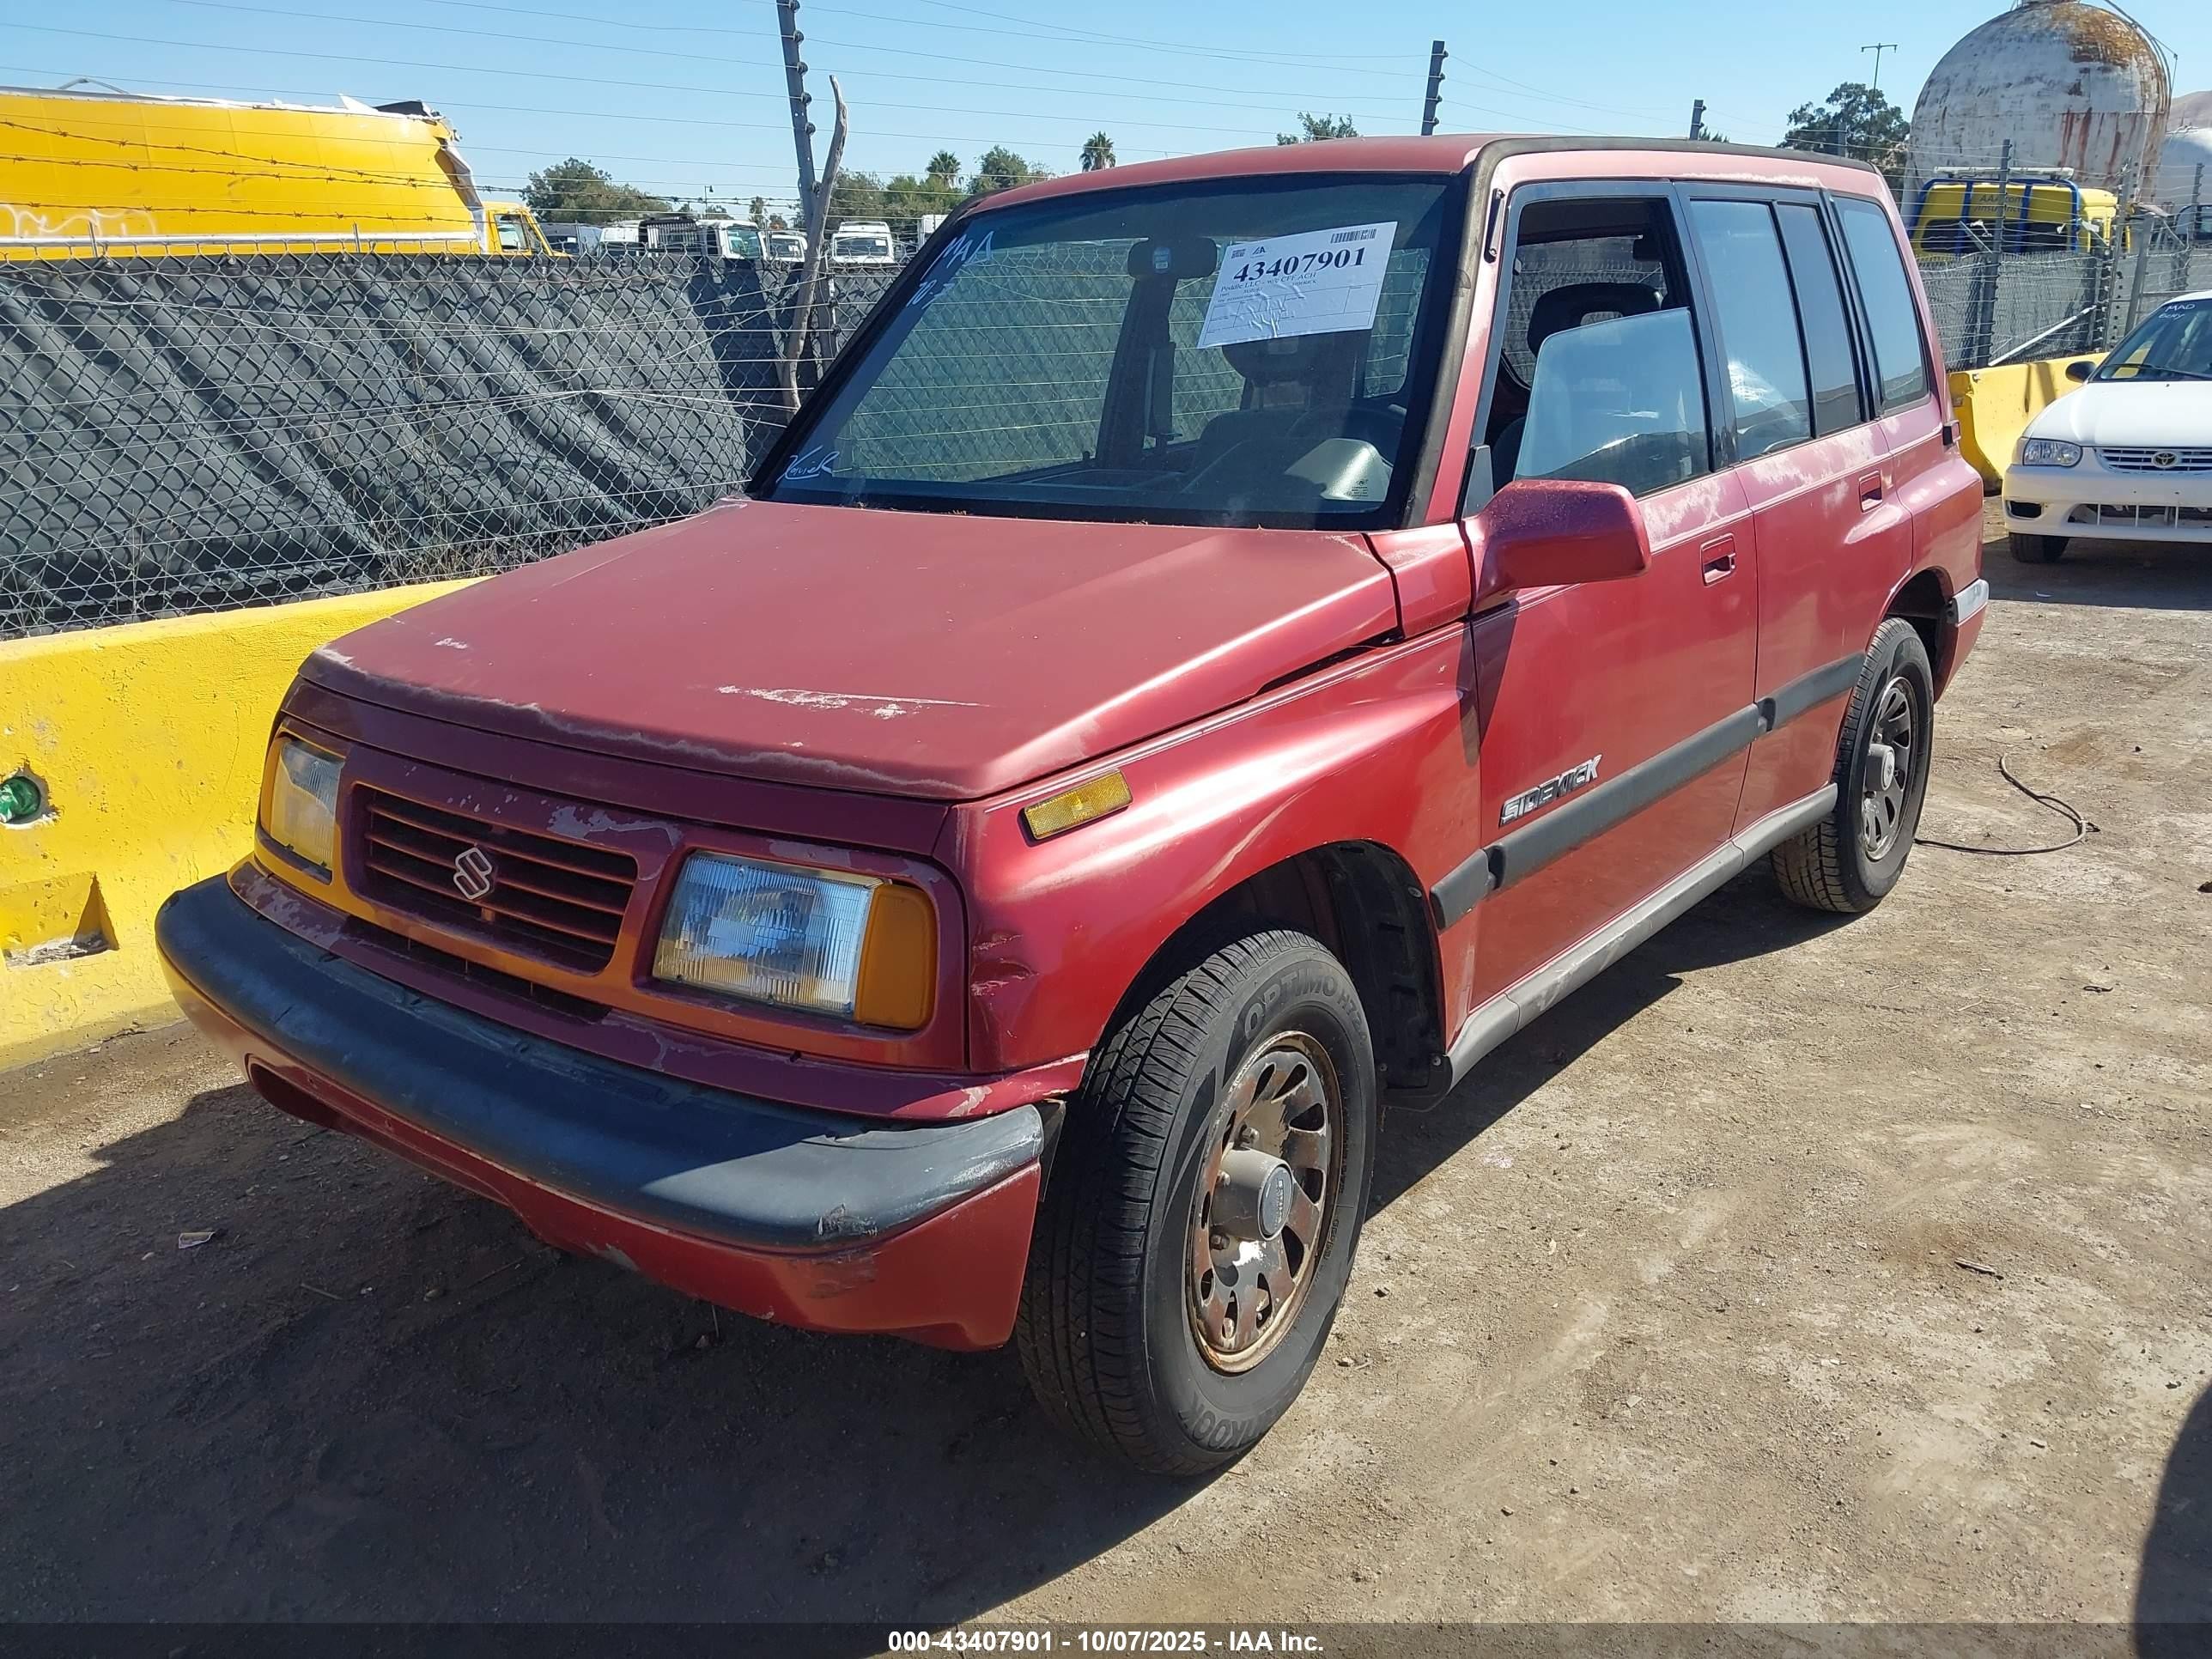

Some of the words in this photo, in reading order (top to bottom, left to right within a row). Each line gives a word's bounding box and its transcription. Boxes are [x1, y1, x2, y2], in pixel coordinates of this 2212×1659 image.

[1233, 246, 1366, 283] 43407901
[2165, 303, 2196, 313] MAD
[1498, 753, 1603, 828] SIDEKICK
[1244, 967, 1339, 1041] OPTIMO
